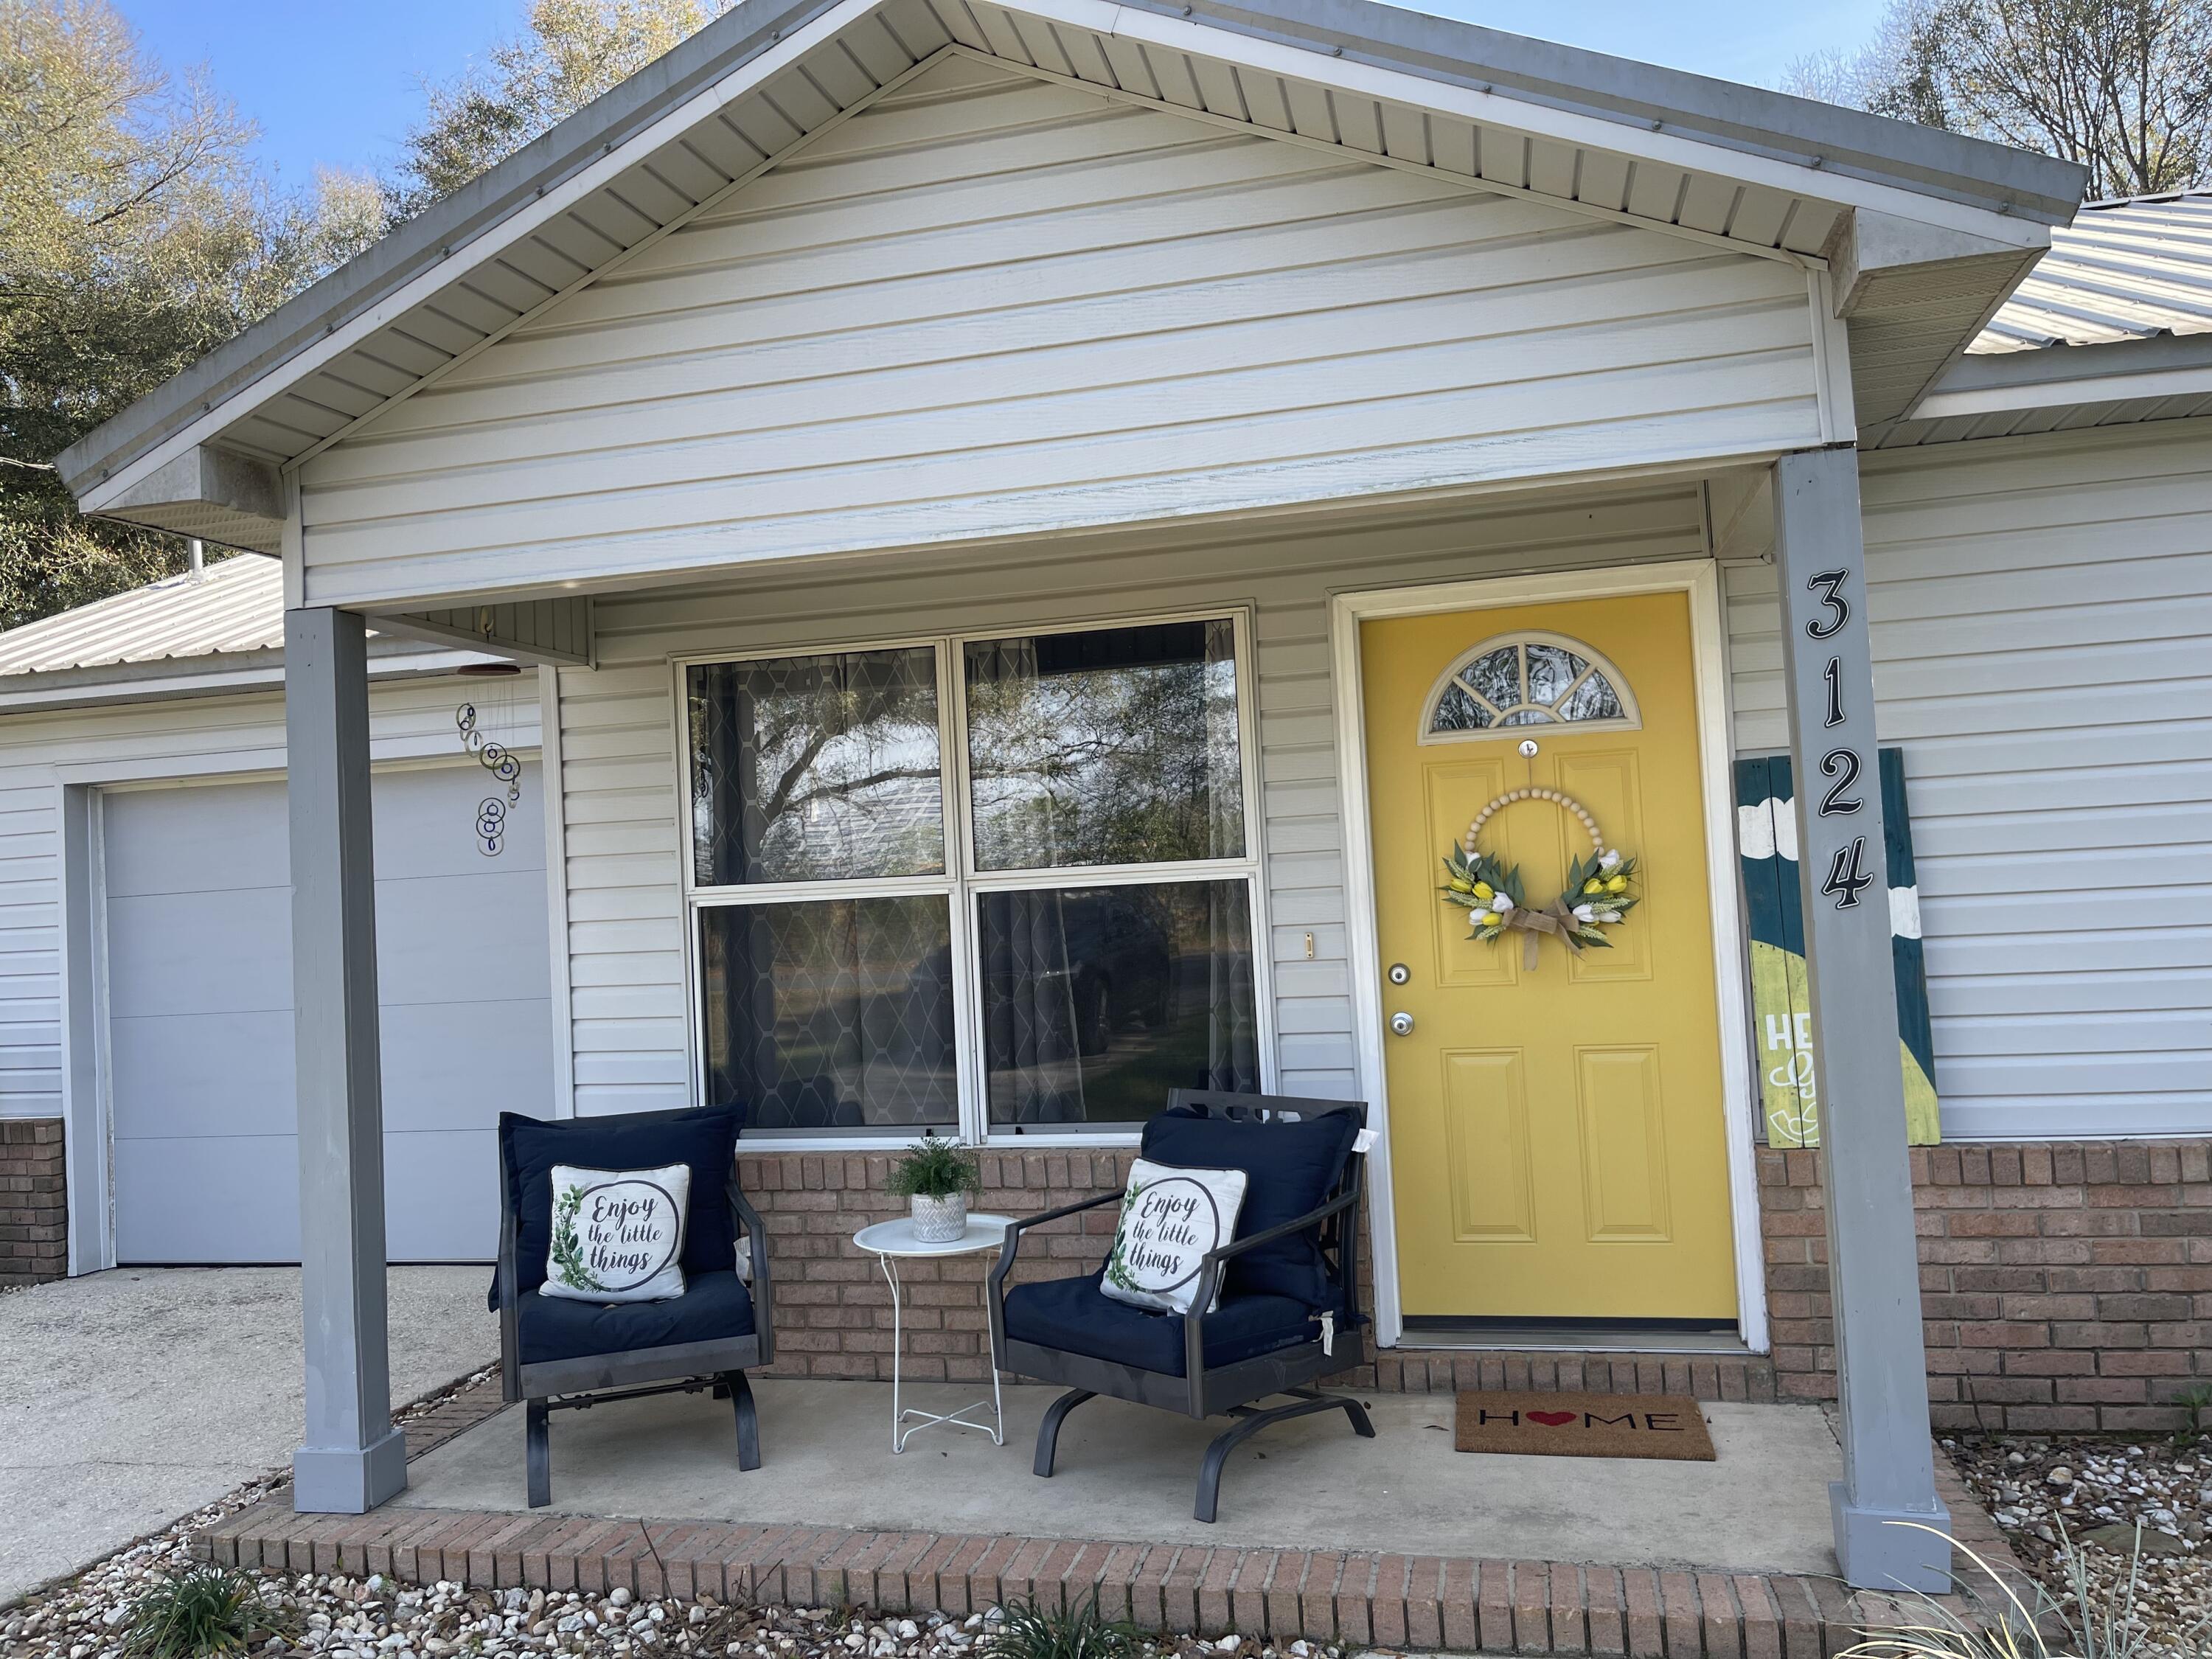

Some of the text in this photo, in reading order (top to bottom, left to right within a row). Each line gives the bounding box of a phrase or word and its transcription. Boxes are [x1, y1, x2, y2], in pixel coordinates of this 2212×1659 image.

[1806, 568, 1874, 910] 3124
[1766, 1012, 1812, 1050] HE
[592, 1195, 658, 1230] Enjoy
[1141, 1192, 1200, 1227] Enjoy
[588, 1224, 663, 1245] the little
[1133, 1220, 1198, 1246] the little
[590, 1245, 653, 1274] things
[1130, 1242, 1183, 1277] things
